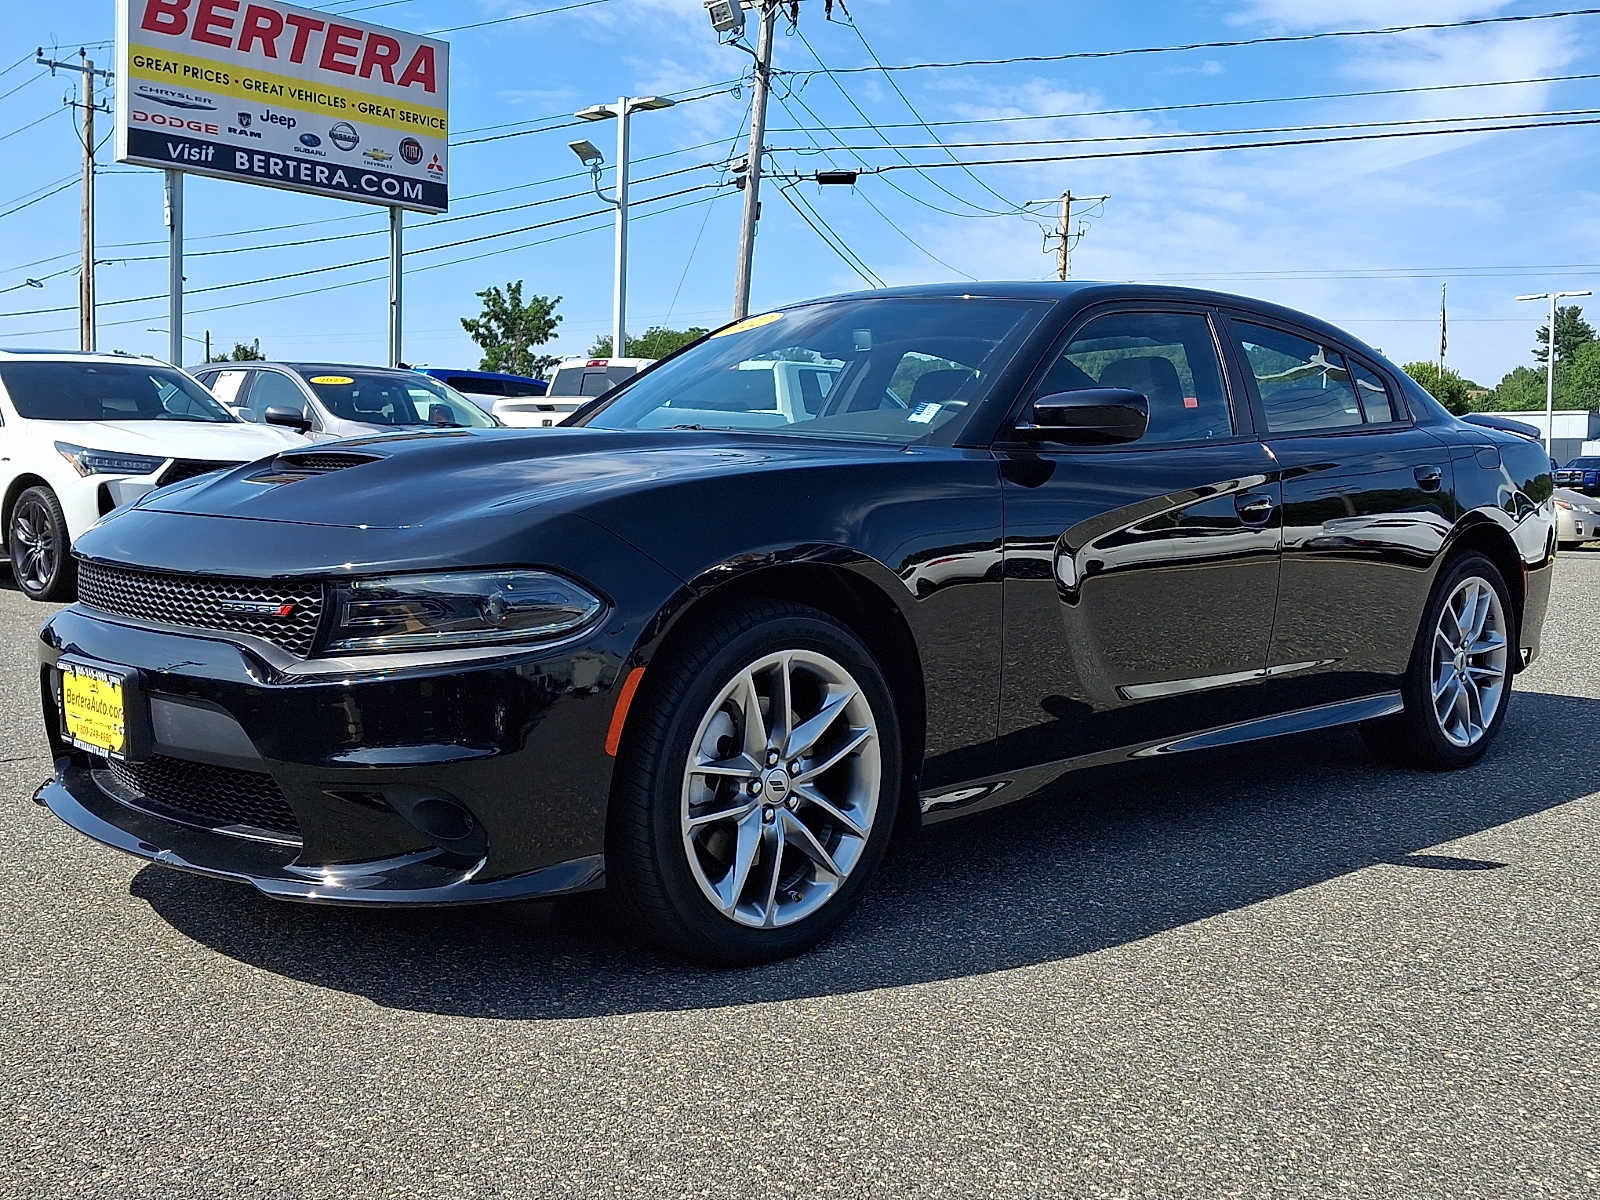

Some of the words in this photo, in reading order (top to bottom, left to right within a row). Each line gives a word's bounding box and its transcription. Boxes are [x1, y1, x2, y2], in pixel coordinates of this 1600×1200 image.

[141, 0, 436, 93] BERTERA
[133, 56, 178, 74] GREAT
[183, 65, 230, 85] PRICES
[242, 78, 284, 96] GREAT
[288, 87, 346, 109] VEHICLES
[358, 102, 396, 119] GREAT
[399, 110, 446, 130] SERVICE
[139, 85, 213, 104] CHRYSLER
[132, 110, 219, 136] DODGE
[260, 109, 296, 129] Jeep
[227, 126, 262, 139] RAM
[332, 132, 358, 143] NISSAN
[293, 146, 327, 157] SUBARU
[405, 144, 418, 158] FIAT
[167, 142, 215, 162] Visit
[235, 151, 423, 200] BERTERA.COM
